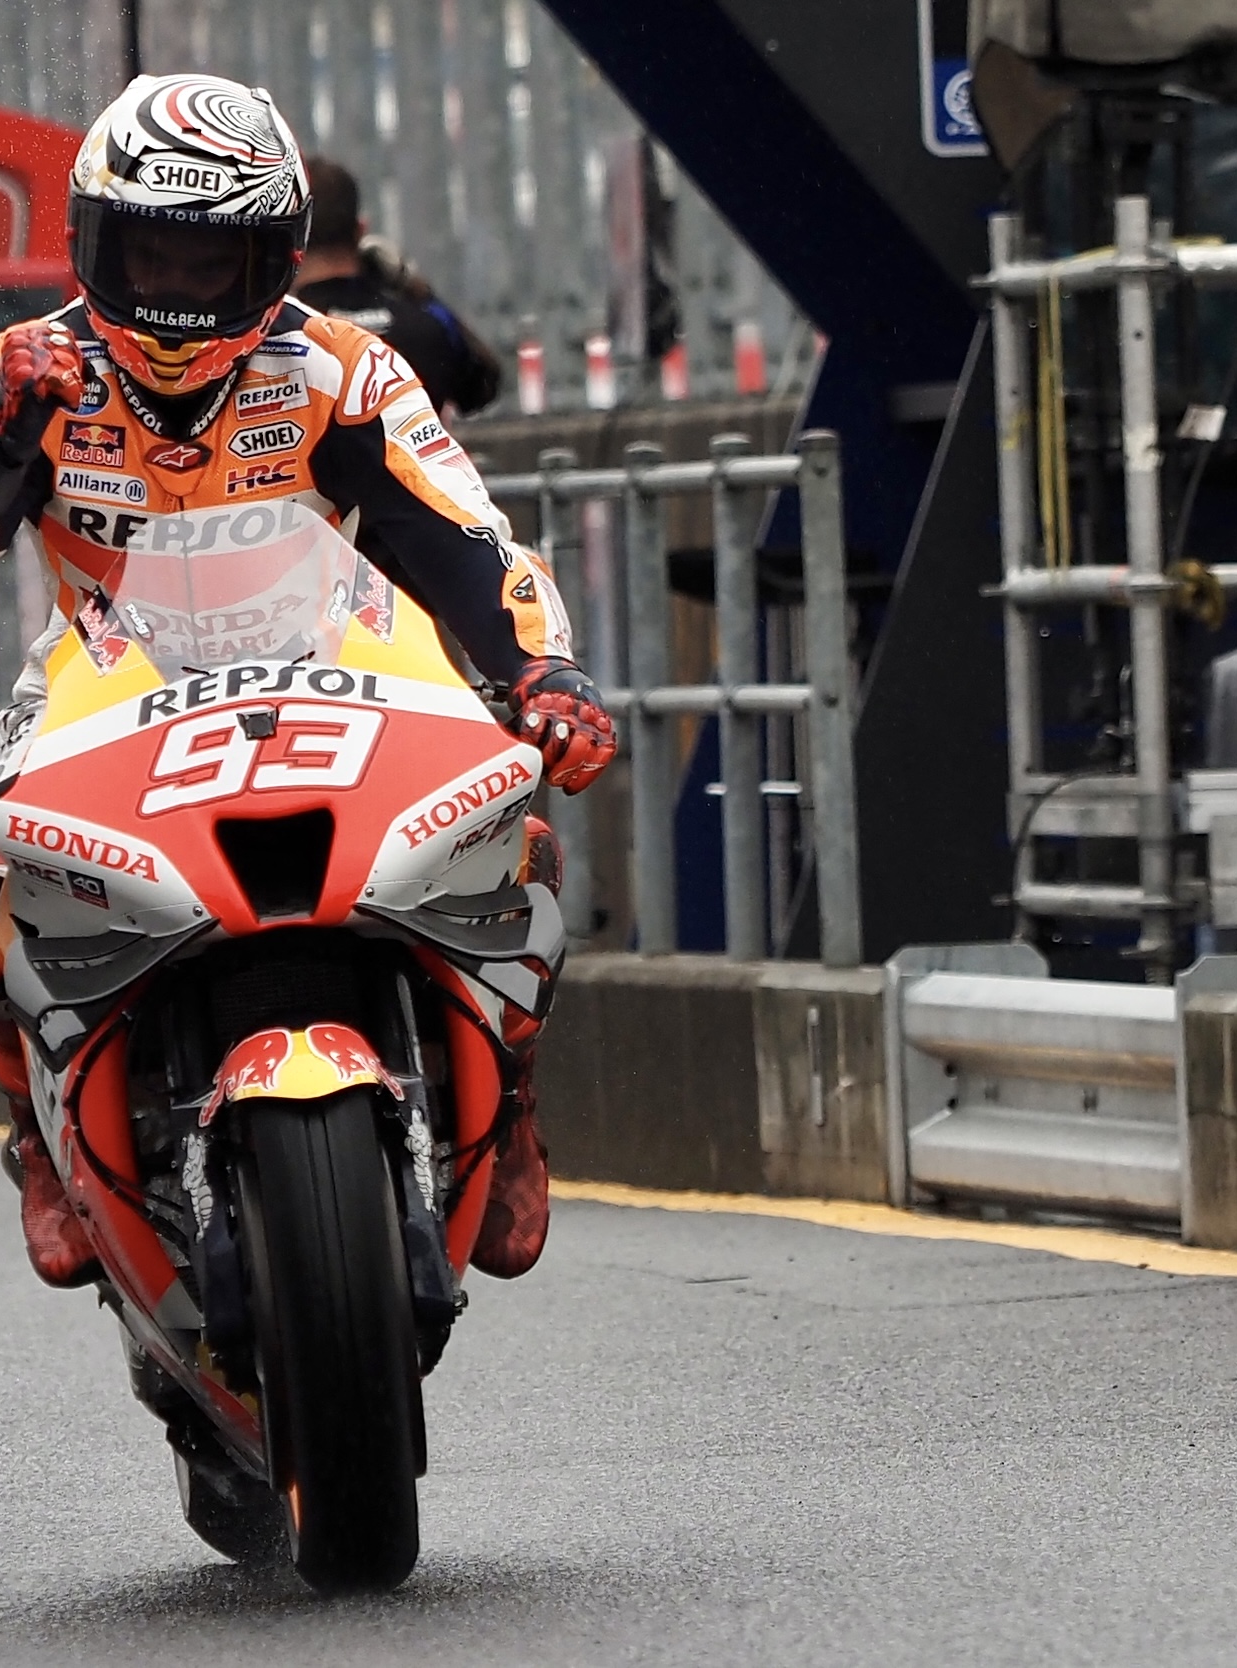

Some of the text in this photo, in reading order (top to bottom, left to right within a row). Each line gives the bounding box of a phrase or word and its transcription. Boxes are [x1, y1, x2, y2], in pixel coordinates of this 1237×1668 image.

[152, 165, 221, 193] SHOEI
[112, 201, 261, 226] GIVES YOU WINGS
[135, 306, 216, 328] PULL&BEAR
[118, 371, 163, 435] REPSOL
[239, 383, 302, 406] REPSOL
[62, 443, 124, 467] Red Bull
[239, 426, 294, 453] SHOEI
[59, 472, 121, 495] Allianz
[227, 457, 298, 494] HRC
[68, 498, 303, 551] REPSOL
[125, 603, 150, 635] Puig
[136, 593, 309, 638] ONDA
[137, 664, 388, 727] REPSOL
[138, 699, 387, 819] 93
[398, 761, 533, 849] HONDA
[6, 815, 160, 883] HONDA
